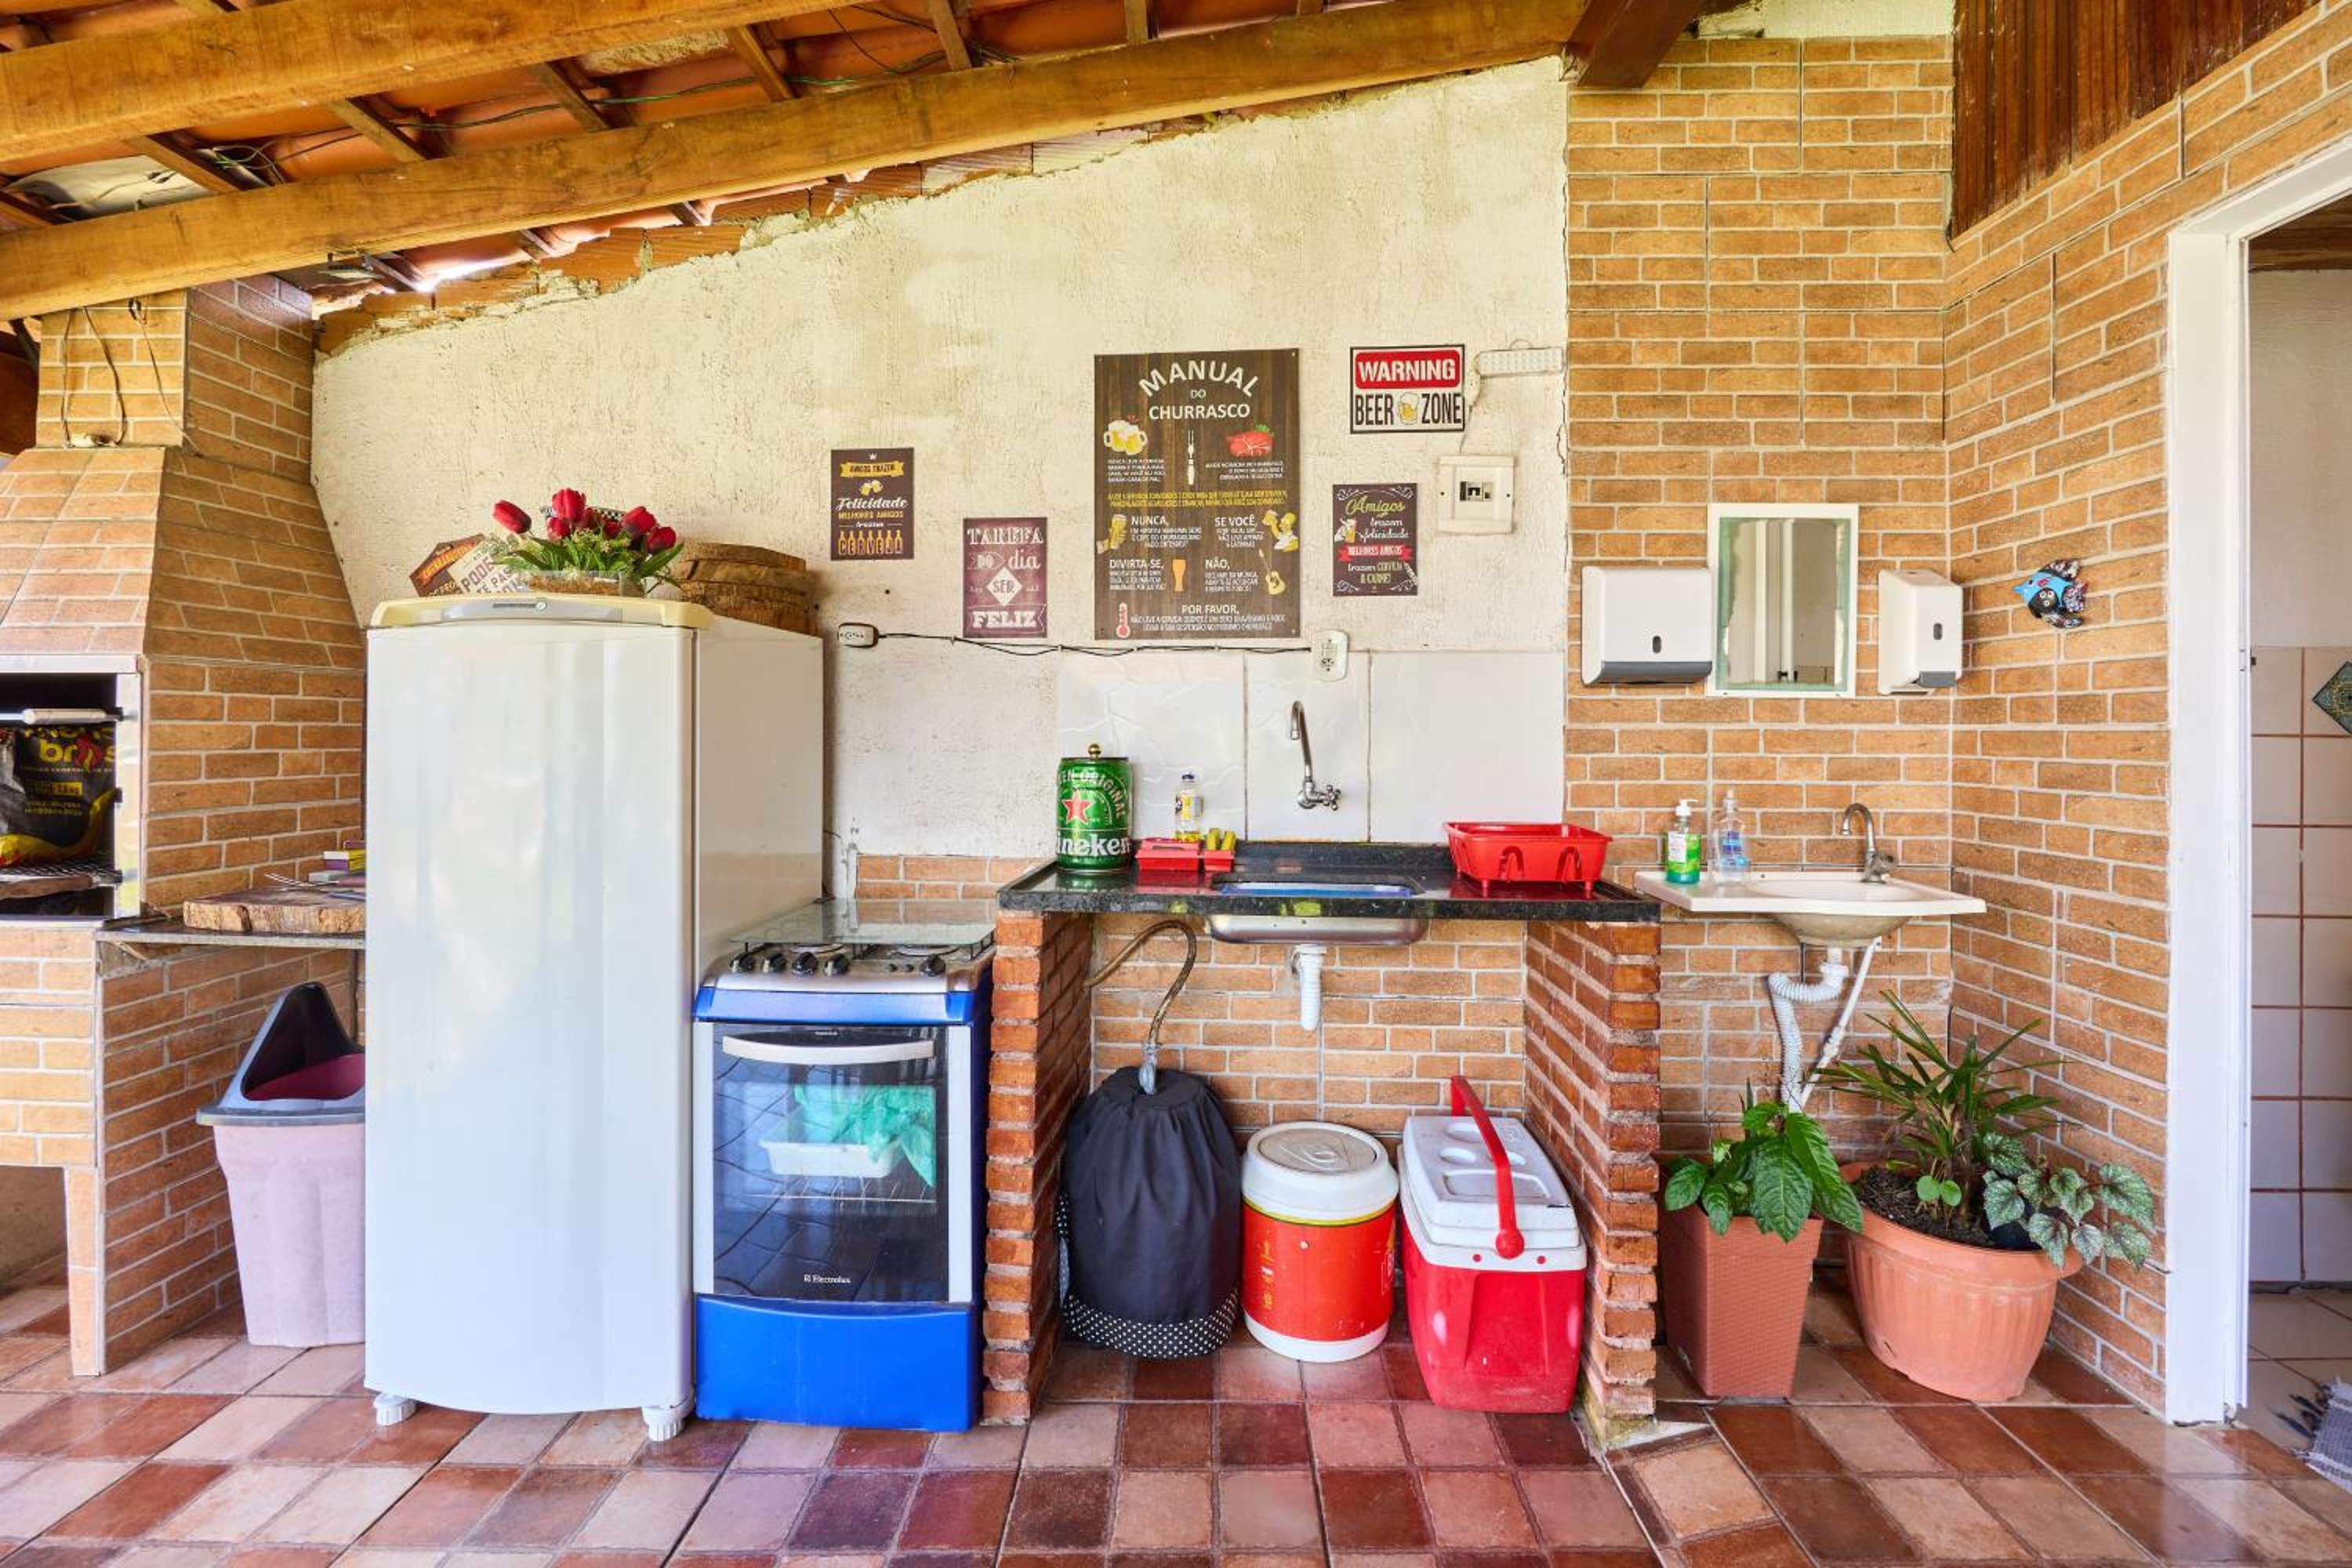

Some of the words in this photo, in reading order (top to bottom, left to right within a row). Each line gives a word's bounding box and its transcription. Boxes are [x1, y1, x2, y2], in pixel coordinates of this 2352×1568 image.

[1138, 360, 1259, 397] MANUAL
[1358, 359, 1456, 382] WARNING
[1190, 390, 1207, 399] DO
[1149, 404, 1250, 420] CHURRASCO
[1355, 394, 1394, 425] BEER
[1421, 393, 1461, 424] ZONE
[835, 496, 909, 511] Felicidade
[1345, 495, 1406, 517] Amigos
[1131, 515, 1170, 526] NUNCA,
[1214, 517, 1227, 527] SE
[1229, 514, 1258, 528] VOCÊ,
[967, 527, 1044, 545] TAREFA
[978, 555, 994, 568] DO
[1008, 549, 1041, 569] dia
[1205, 557, 1231, 570] NÃO,
[993, 579, 1015, 593] SER
[1181, 604, 1202, 615] POR
[1205, 604, 1240, 615] FAVOR,
[972, 611, 1037, 628] FELIZ
